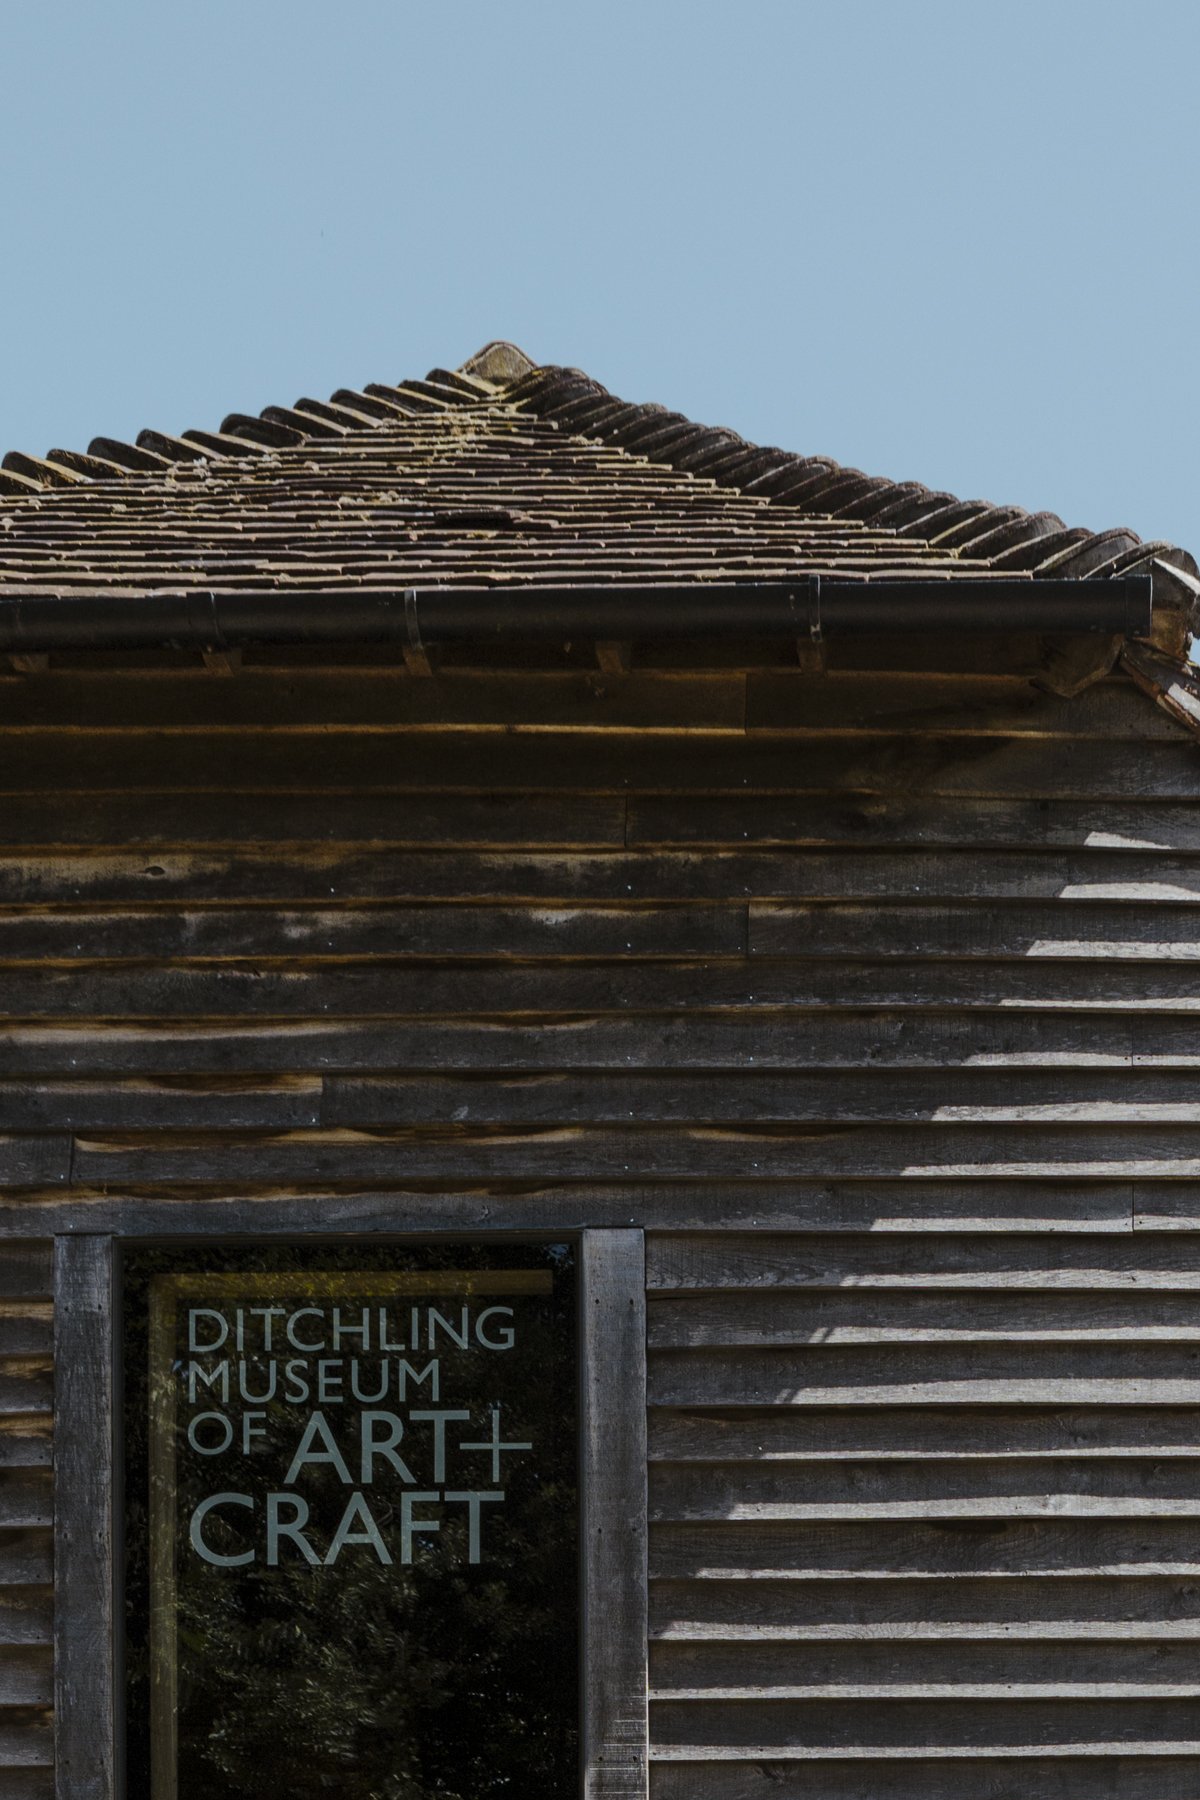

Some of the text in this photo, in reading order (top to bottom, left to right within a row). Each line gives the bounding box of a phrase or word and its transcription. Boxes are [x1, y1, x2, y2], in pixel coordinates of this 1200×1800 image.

[188, 1307, 515, 1352] DITCHLING
[188, 1359, 440, 1403] MUSEUM
[188, 1412, 267, 1455] OF
[189, 1491, 505, 1567] CRAFT
